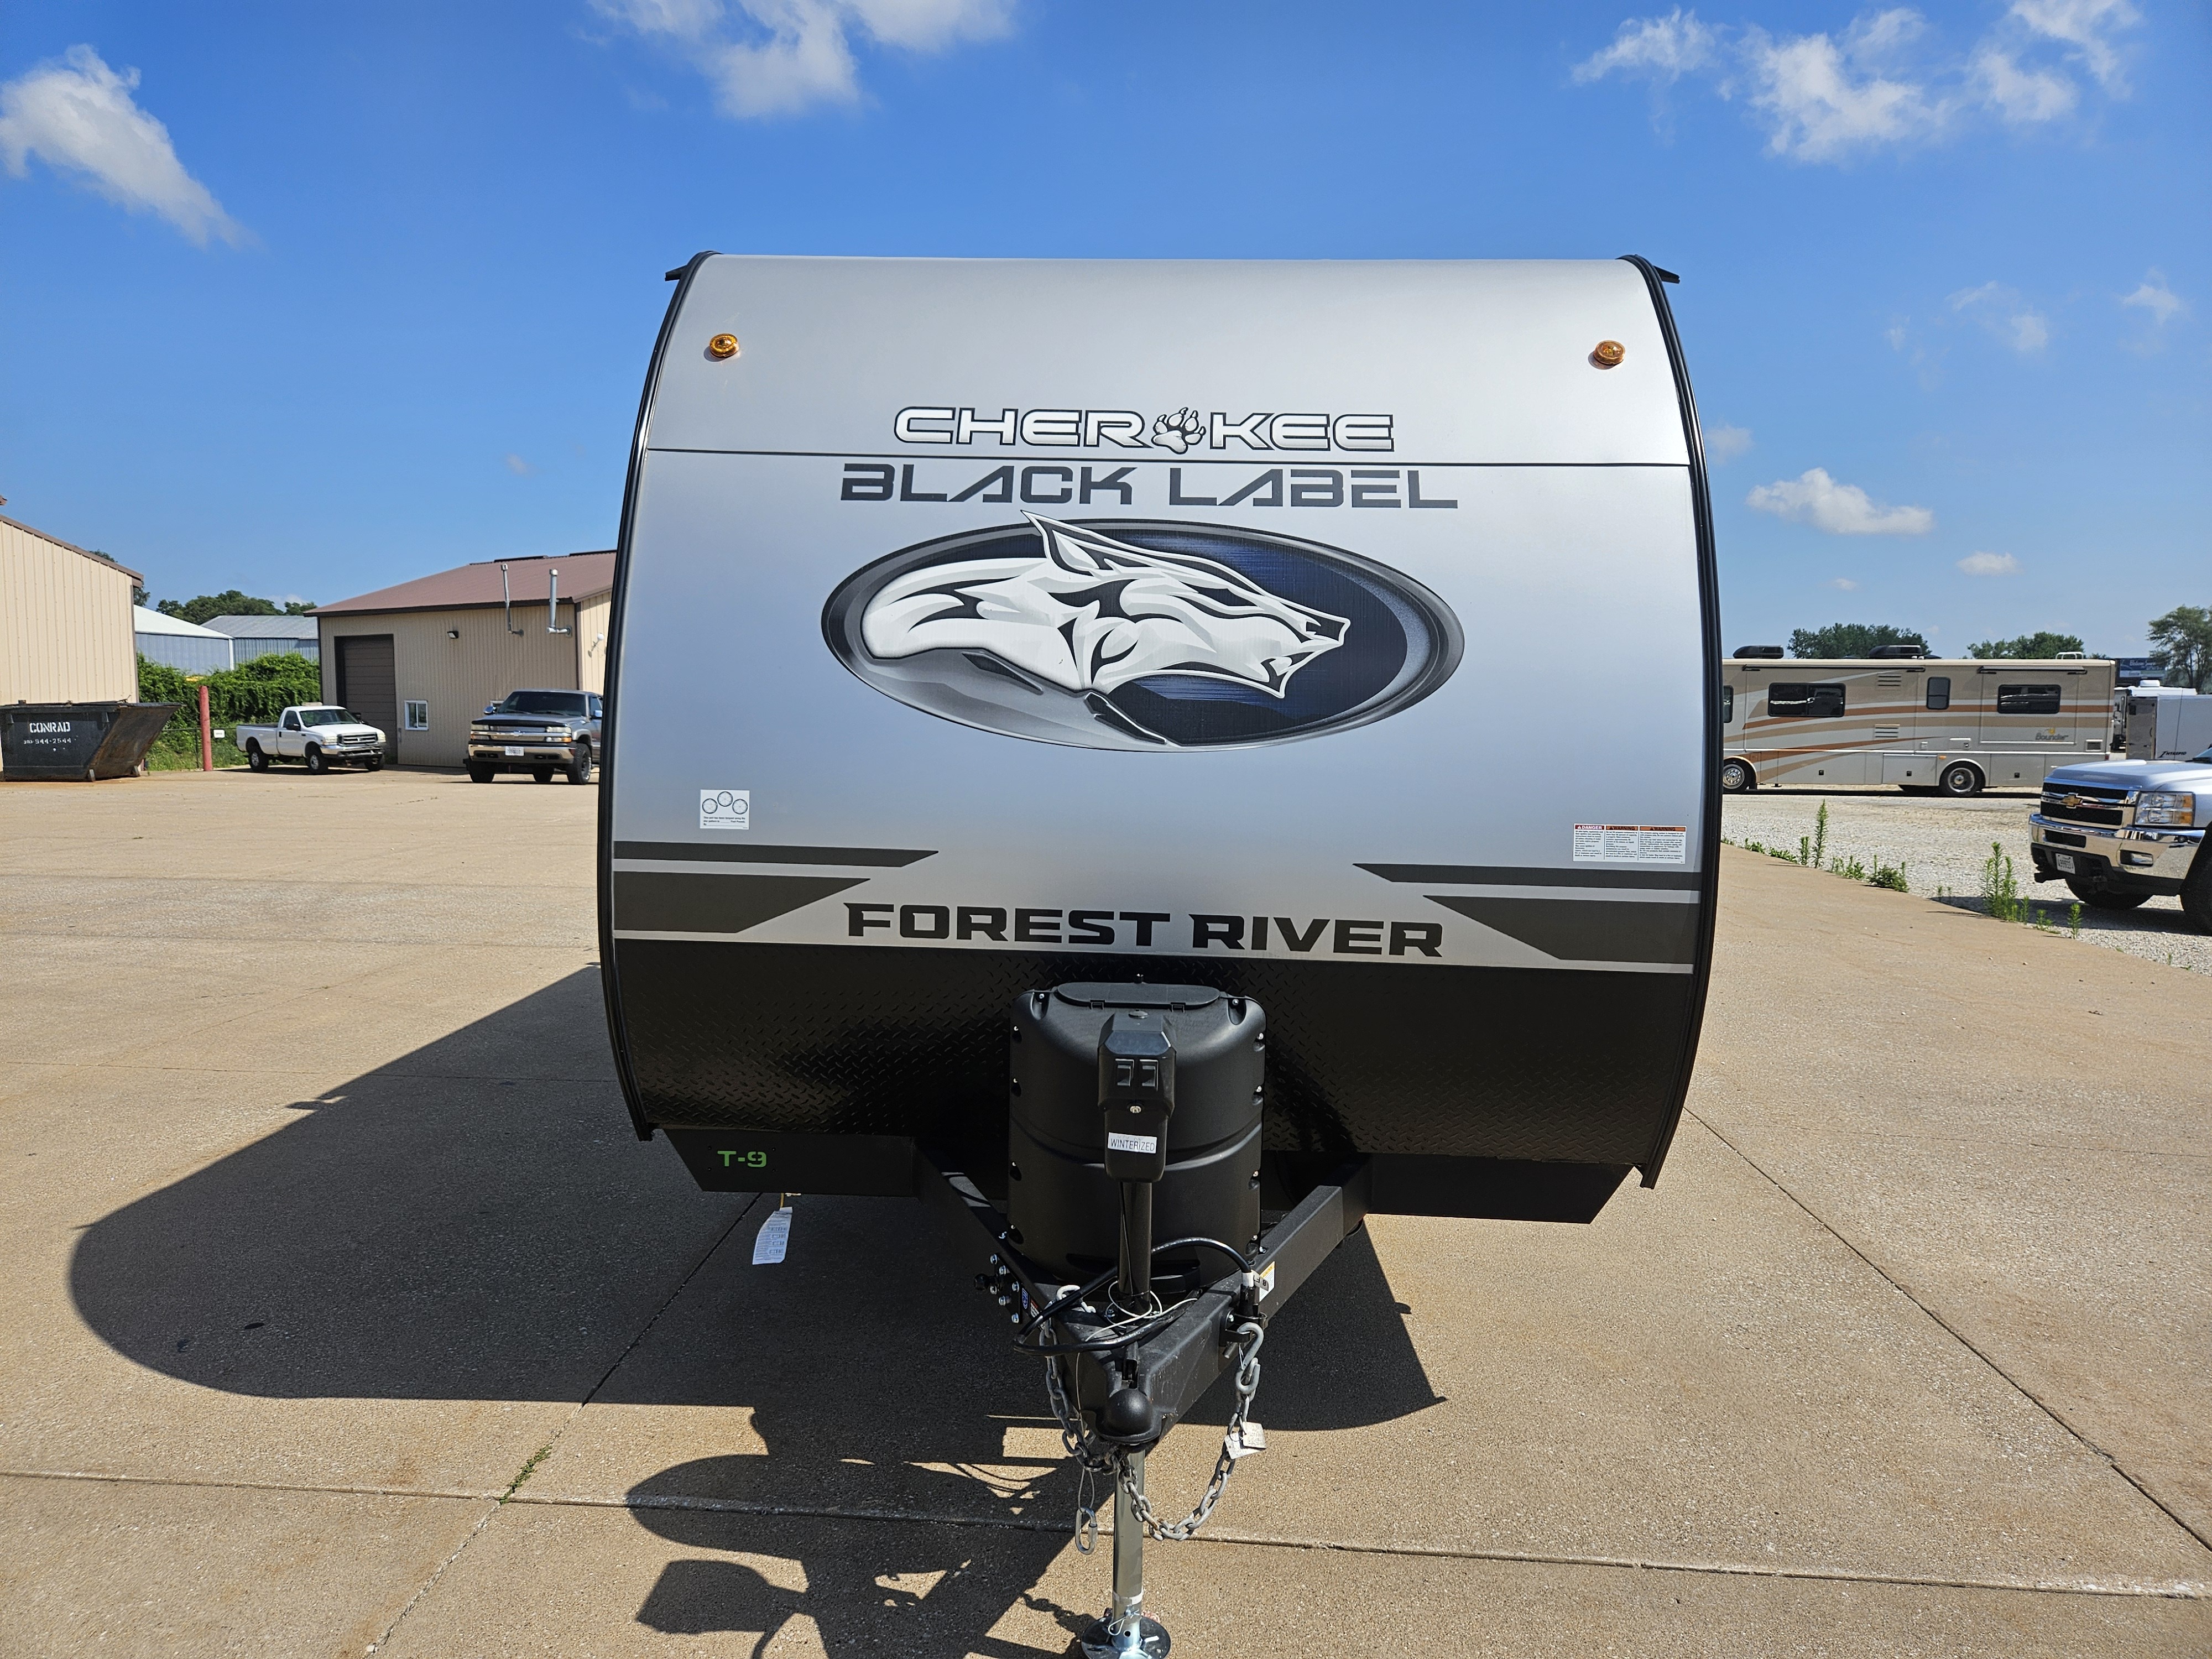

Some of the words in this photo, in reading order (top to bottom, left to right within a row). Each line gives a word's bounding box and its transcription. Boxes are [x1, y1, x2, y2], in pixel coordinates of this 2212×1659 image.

[841, 463, 1138, 505] BLACK
[1170, 467, 1458, 509] LABEL
[29, 721, 71, 733] CONRAD
[843, 902, 1171, 947] FOREST
[1188, 914, 1443, 958] RIVER
[1111, 1138, 1155, 1151] WINTERIZED
[717, 1150, 767, 1167] T-9
